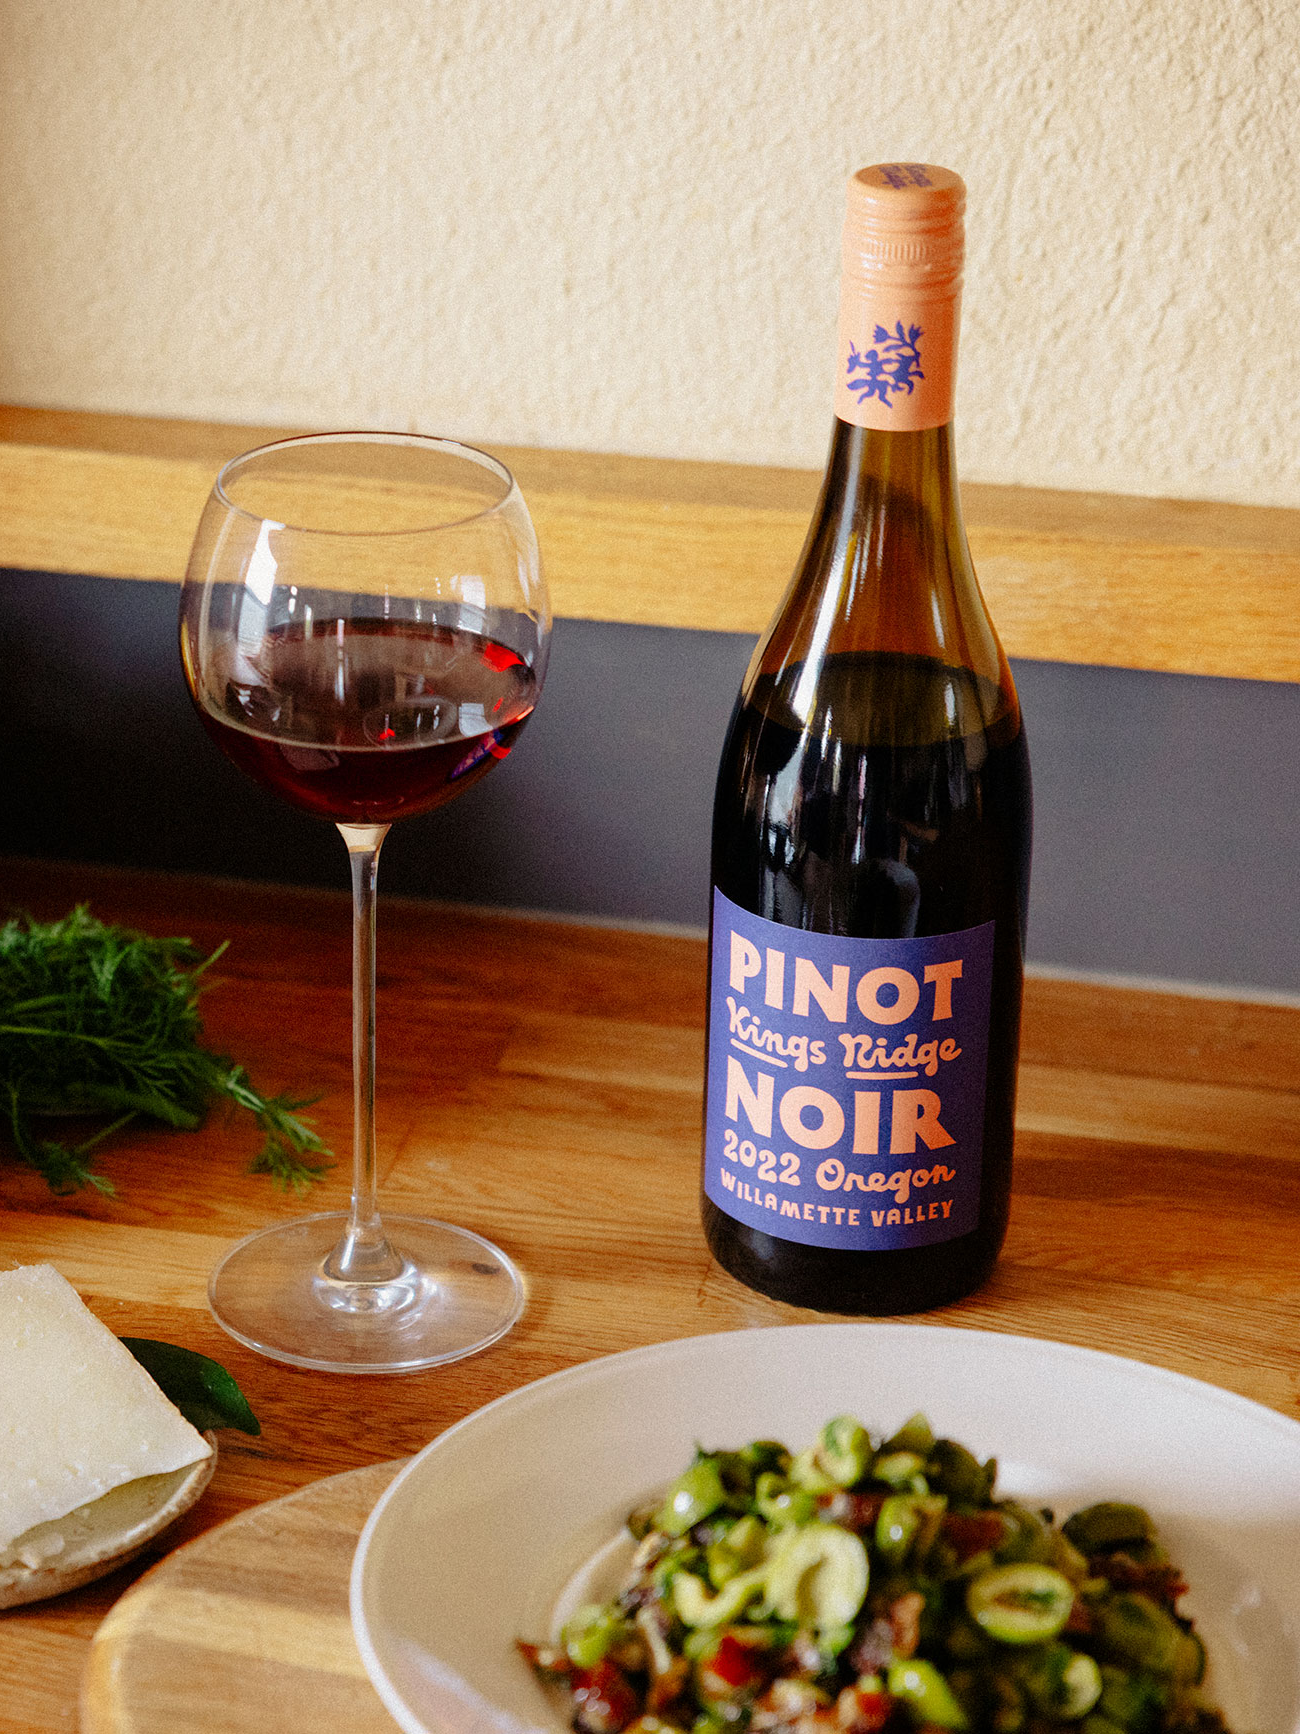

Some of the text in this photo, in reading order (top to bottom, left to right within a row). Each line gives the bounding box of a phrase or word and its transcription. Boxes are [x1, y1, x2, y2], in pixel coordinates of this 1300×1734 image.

[729, 930, 963, 1025] PINOT
[726, 996, 962, 1076] Kings Ridge
[724, 1055, 957, 1155] NOIR
[720, 1168, 954, 1227] WILLAMETTE VALLEY
[723, 1129, 956, 1203] 2022 Oregon
